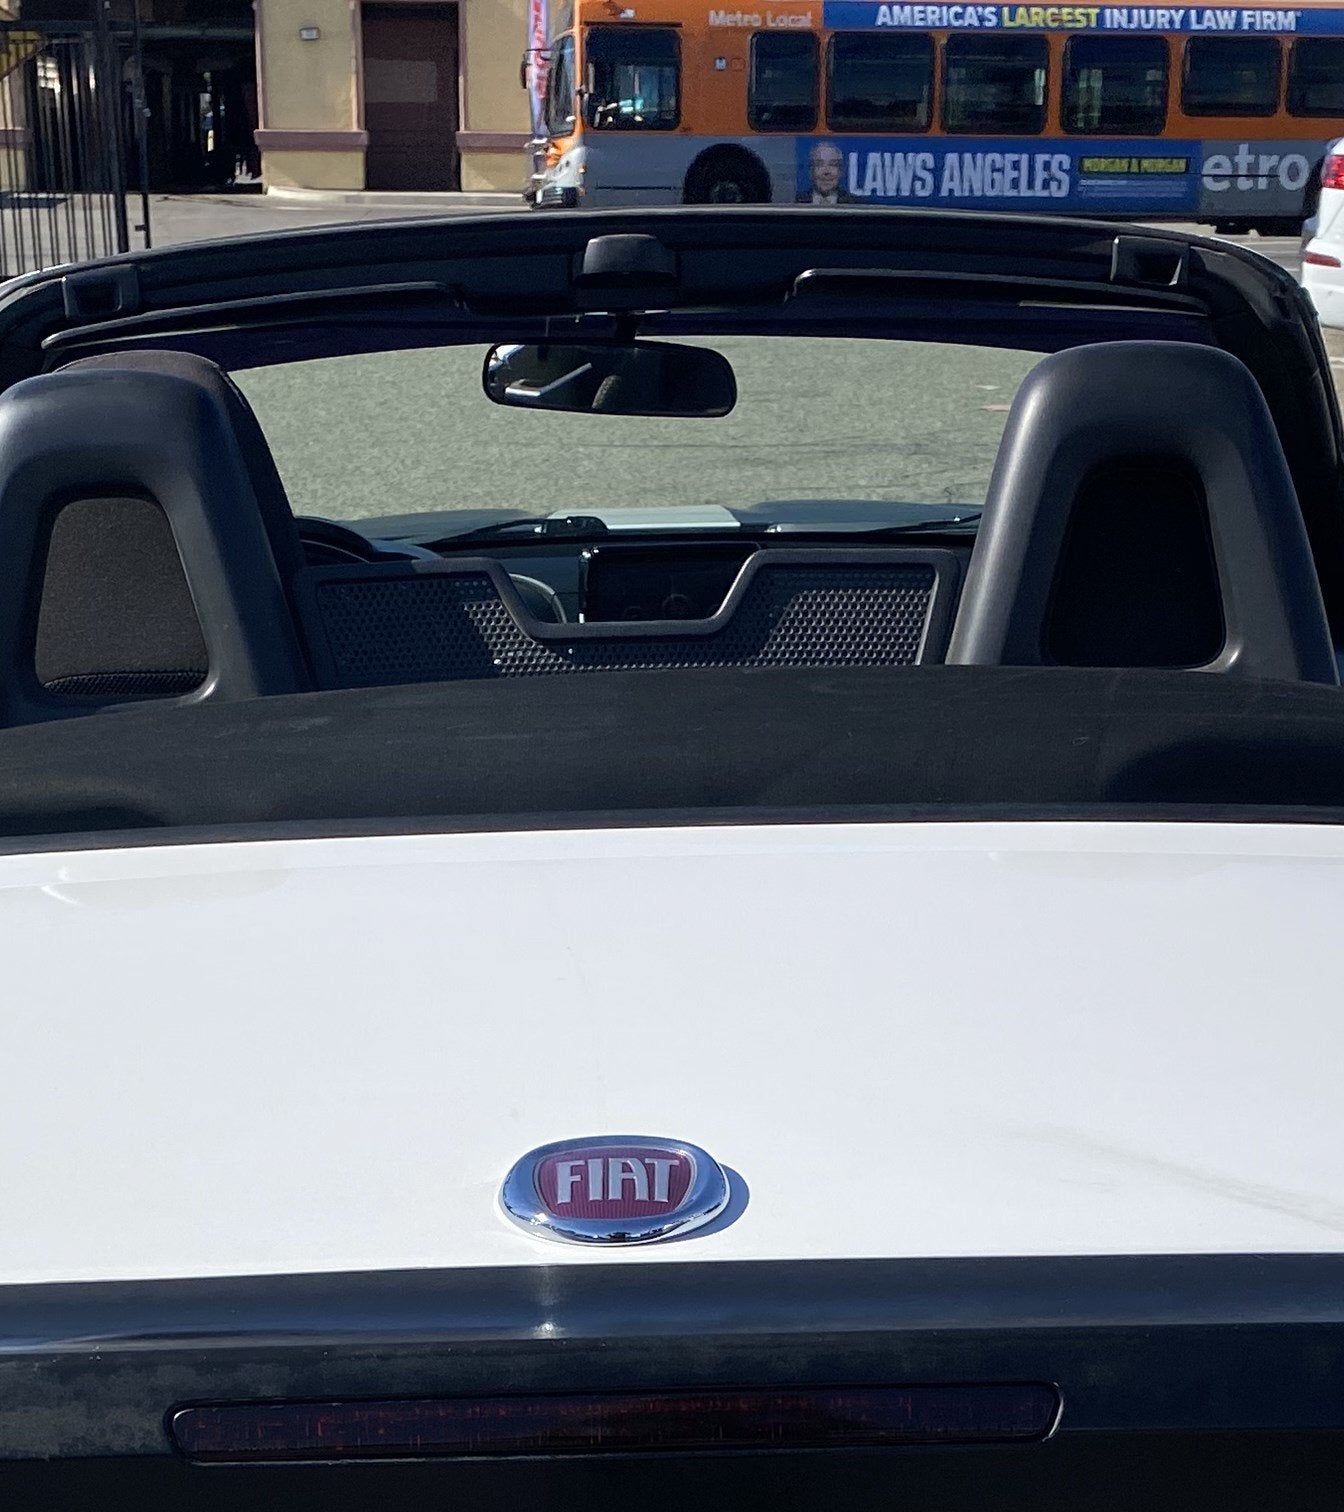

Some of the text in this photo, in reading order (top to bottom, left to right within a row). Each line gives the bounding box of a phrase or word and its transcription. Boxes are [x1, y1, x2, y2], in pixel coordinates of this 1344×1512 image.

[708, 10, 812, 28] Metro Local
[875, 5, 998, 27] AMERICA'S
[1002, 6, 1099, 28] LARGEST
[1103, 8, 1184, 30] INJURY
[1189, 9, 1237, 31] LAW
[848, 151, 1071, 198] LAWS ANGELES
[1202, 143, 1310, 191] etro
[555, 1157, 680, 1205] FIAT
